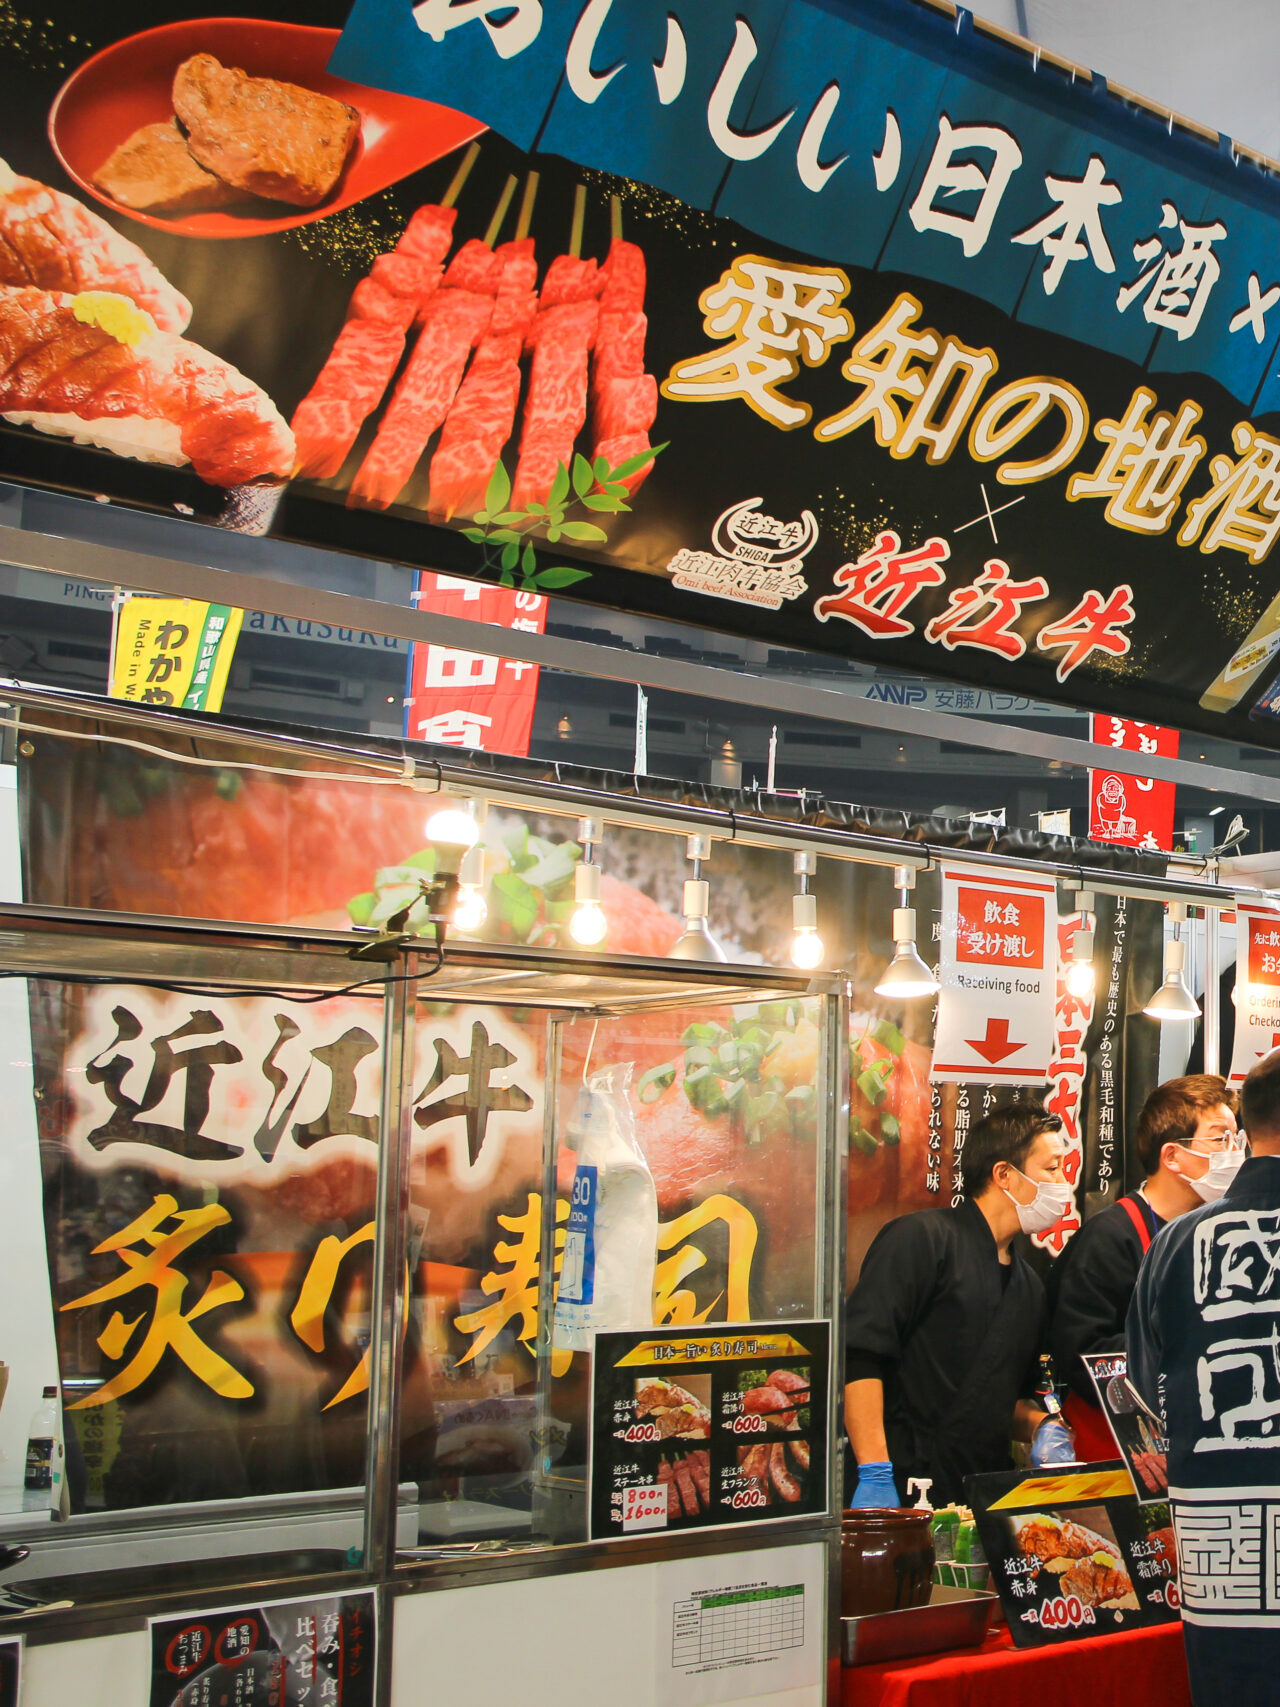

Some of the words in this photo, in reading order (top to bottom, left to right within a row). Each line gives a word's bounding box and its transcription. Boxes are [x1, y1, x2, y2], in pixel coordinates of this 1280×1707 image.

[735, 515, 799, 543] 近江牛
[735, 546, 769, 562] SHIGA
[672, 552, 803, 597] 近江肉牛協会
[676, 575, 699, 588] Omi
[701, 580, 724, 593] beef
[725, 587, 779, 606] Association
[814, 530, 1135, 683] 近江牛
[135, 619, 151, 659] Made
[983, 900, 1020, 925] 飲食
[966, 932, 1035, 958] 受け渡し
[958, 975, 1012, 994] Receiving
[1015, 978, 1040, 993] food
[86, 1005, 534, 1168] 近江牛
[59, 1193, 759, 1412] 炙り寿司
[653, 1342, 708, 1360] 日本一旨い
[712, 1340, 758, 1356] 炙り寿司
[614, 1399, 640, 1411] 近江牛
[722, 1391, 747, 1402] 近江牛
[613, 1464, 640, 1476] 近江牛
[720, 1467, 745, 1478] 近江牛
[1129, 1537, 1167, 1559] 近江牛
[1003, 1554, 1045, 1576] 近江牛
[1136, 1558, 1172, 1580] 霜降り
[1010, 1577, 1039, 1598] 赤身
[348, 1608, 365, 1678] イチオシ
